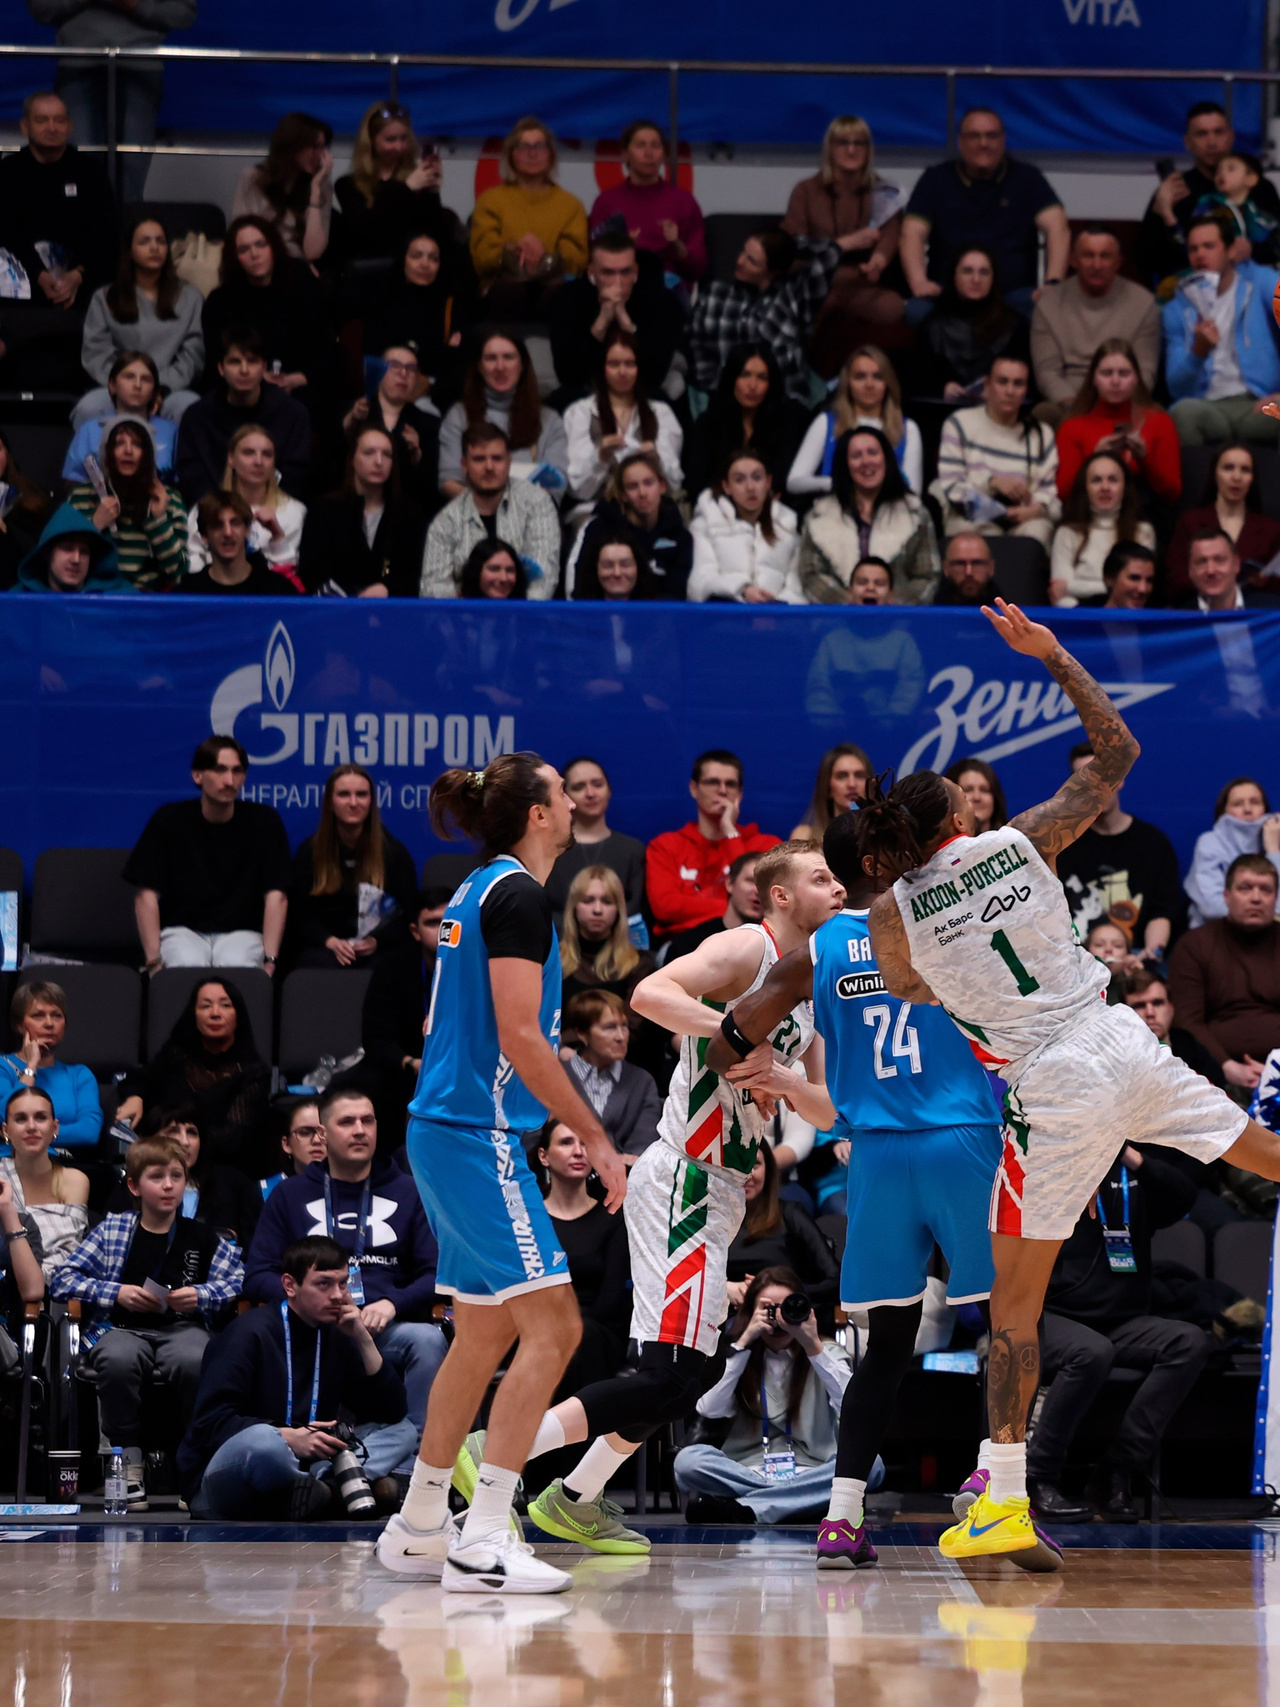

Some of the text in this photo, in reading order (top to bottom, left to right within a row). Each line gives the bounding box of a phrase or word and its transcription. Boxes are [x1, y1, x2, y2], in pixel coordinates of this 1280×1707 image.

[303, 713, 515, 766] ГАЗПРОМ
[910, 843, 1029, 923] AKOON-PURCELL
[934, 911, 974, 936] Ак Барс
[938, 929, 965, 947] Банк
[990, 929, 1040, 997] 1
[863, 1001, 922, 1080] 24
